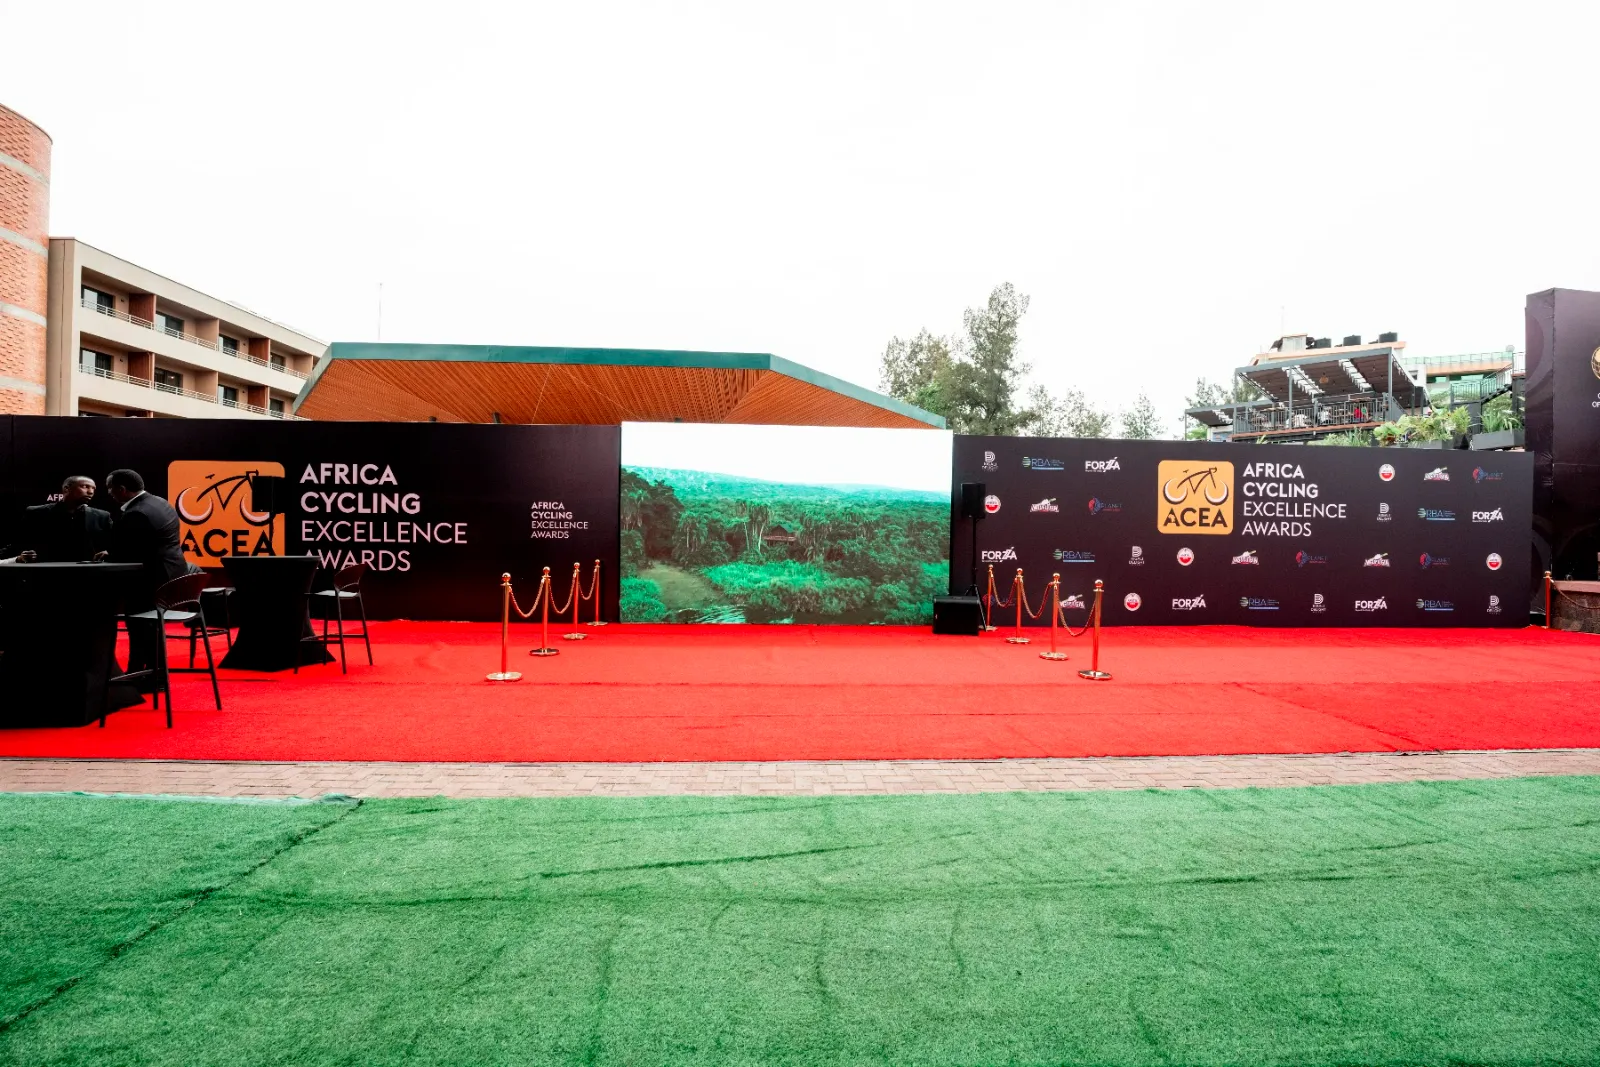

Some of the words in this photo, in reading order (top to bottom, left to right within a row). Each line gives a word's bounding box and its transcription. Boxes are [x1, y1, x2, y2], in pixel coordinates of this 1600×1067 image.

[300, 463, 398, 485] AFRICA
[1243, 463, 1304, 478] AFRICA
[1243, 482, 1319, 498] CYCLING
[300, 492, 421, 514] CYCLING
[531, 501, 565, 510] AFRICA
[1243, 502, 1347, 518] EXCELLENCE
[531, 511, 573, 520] CYCLING
[1163, 508, 1228, 527] ACEA
[301, 521, 468, 544] EXCELLENCE
[531, 521, 589, 530] EXCELLENCE
[1242, 521, 1312, 537] AWARDS
[181, 529, 276, 557] ACEA
[530, 531, 570, 539] AWARDS
